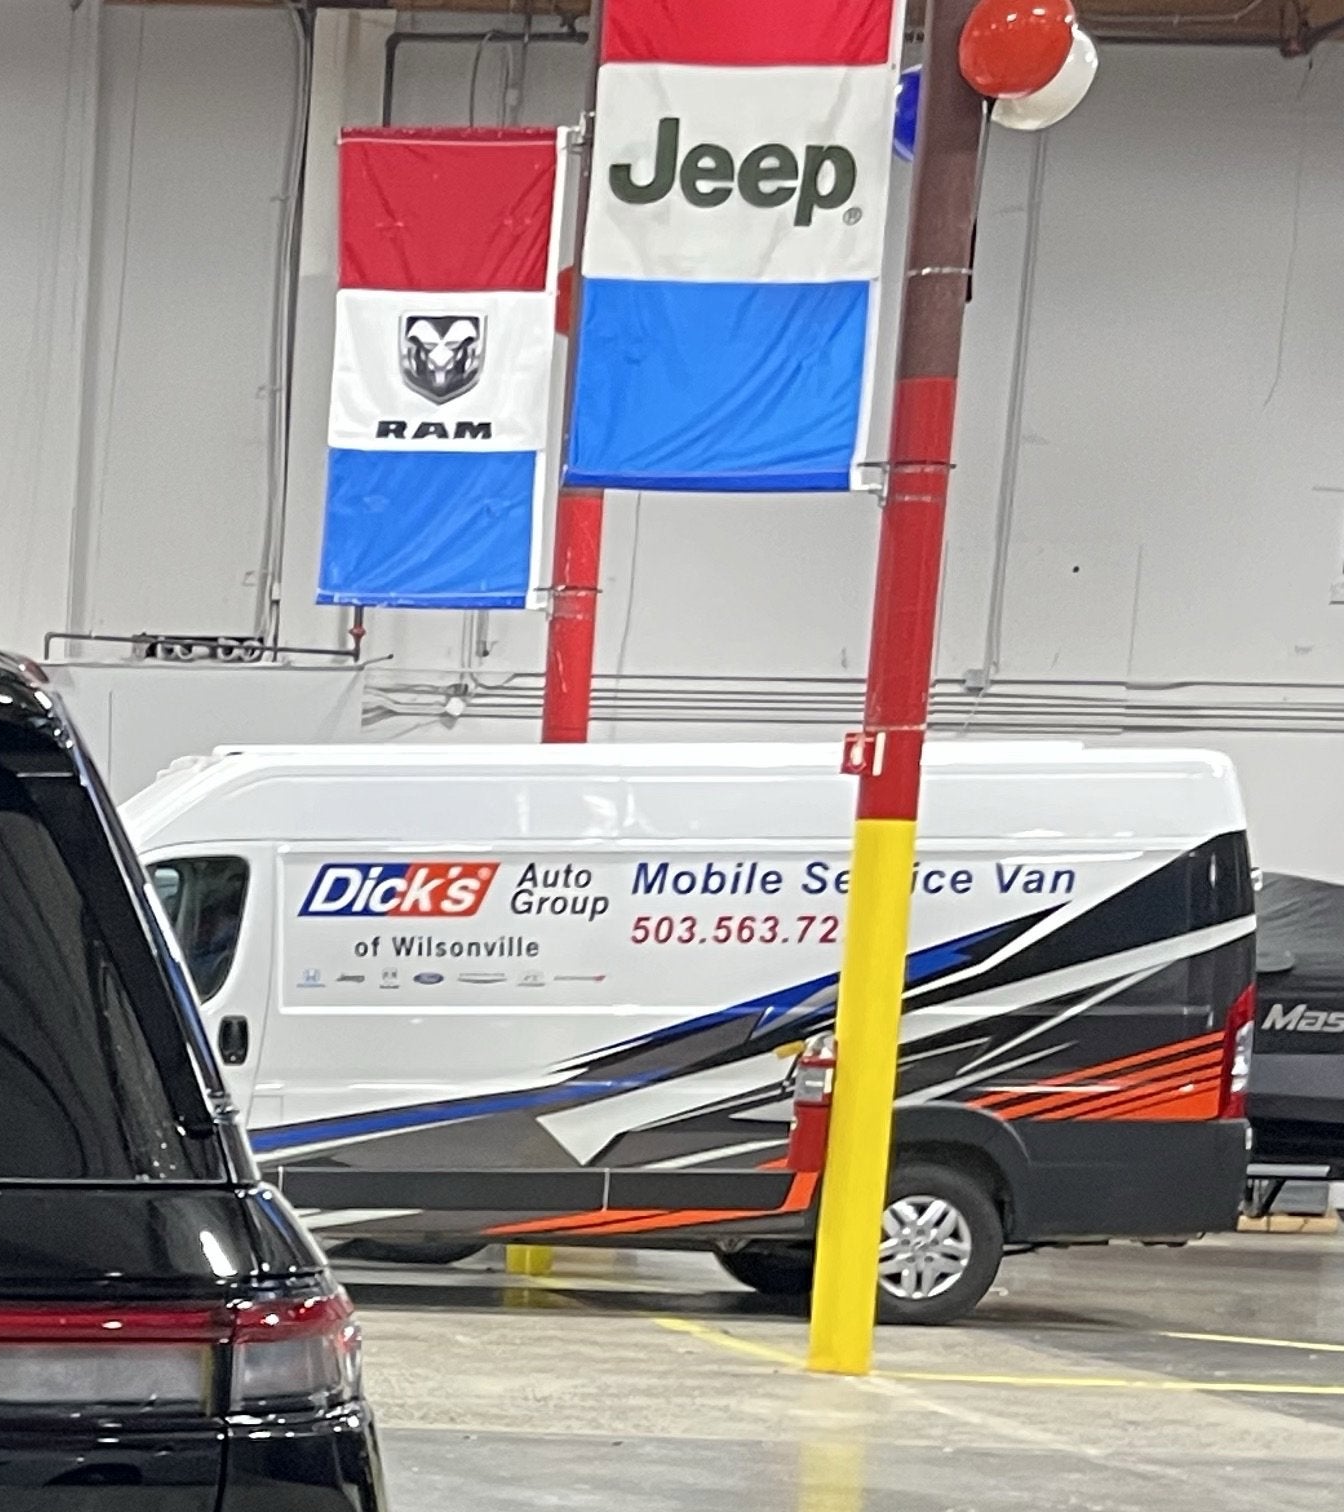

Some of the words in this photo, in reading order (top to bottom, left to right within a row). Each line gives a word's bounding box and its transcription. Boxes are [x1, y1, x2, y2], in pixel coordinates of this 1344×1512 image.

[609, 117, 857, 227] Jeep
[376, 420, 493, 440] RAM
[307, 865, 482, 914] Dick's
[516, 862, 593, 889] Auto
[631, 861, 784, 895] Mobile
[800, 860, 974, 895] Seice
[994, 862, 1077, 894] Van
[510, 888, 610, 922] Group
[354, 935, 381, 958] of
[392, 936, 540, 958] Wilsonville
